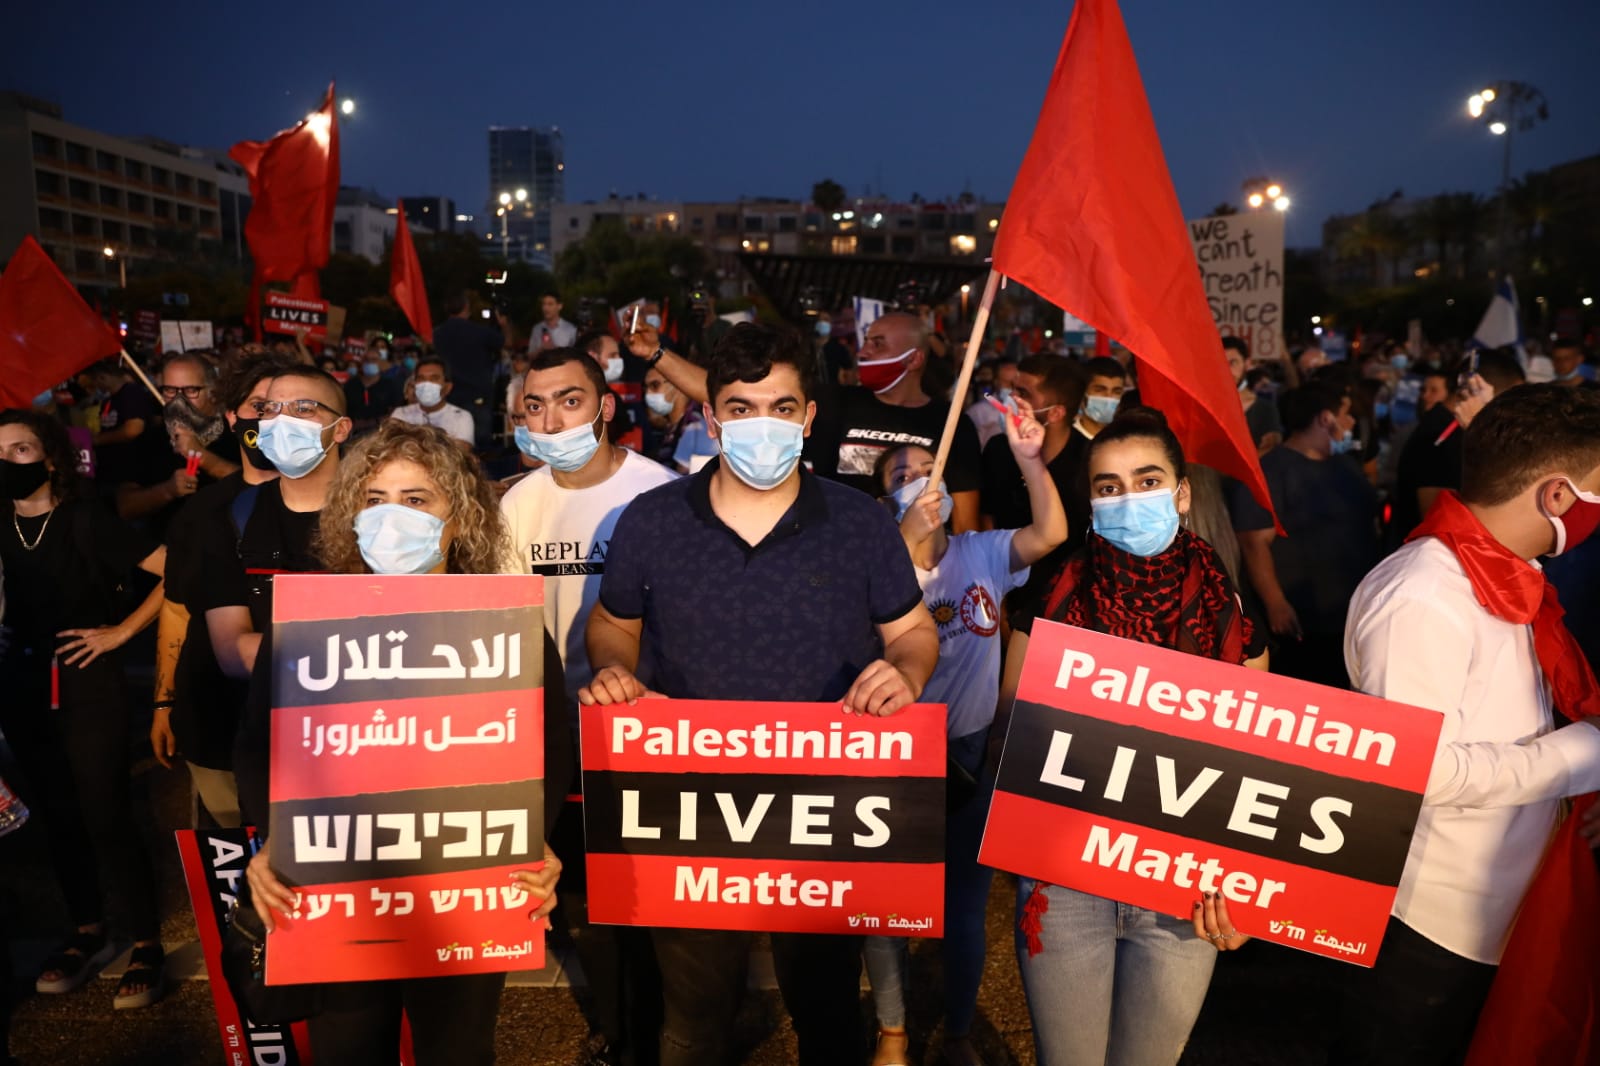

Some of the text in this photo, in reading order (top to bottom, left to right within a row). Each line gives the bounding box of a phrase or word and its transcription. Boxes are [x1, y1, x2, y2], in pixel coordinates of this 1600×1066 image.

[270, 307, 320, 324] LIVES
[271, 296, 324, 310] Palestinian
[846, 428, 933, 447] SKECHERS
[530, 541, 609, 561] REPLA
[556, 563, 594, 575] JEANS
[298, 630, 521, 691] الاحتلال
[1055, 648, 1396, 767] Palestinian
[302, 708, 517, 756] أصل الشرور!
[612, 717, 913, 760] Palestinian
[1039, 729, 1353, 854] LIVES
[293, 809, 528, 863] הכיבוש
[621, 790, 892, 848] LIVES
[674, 866, 853, 907] Matter
[1081, 824, 1287, 909] Matter
[371, 887, 415, 917] כל
[429, 885, 529, 914] שורש
